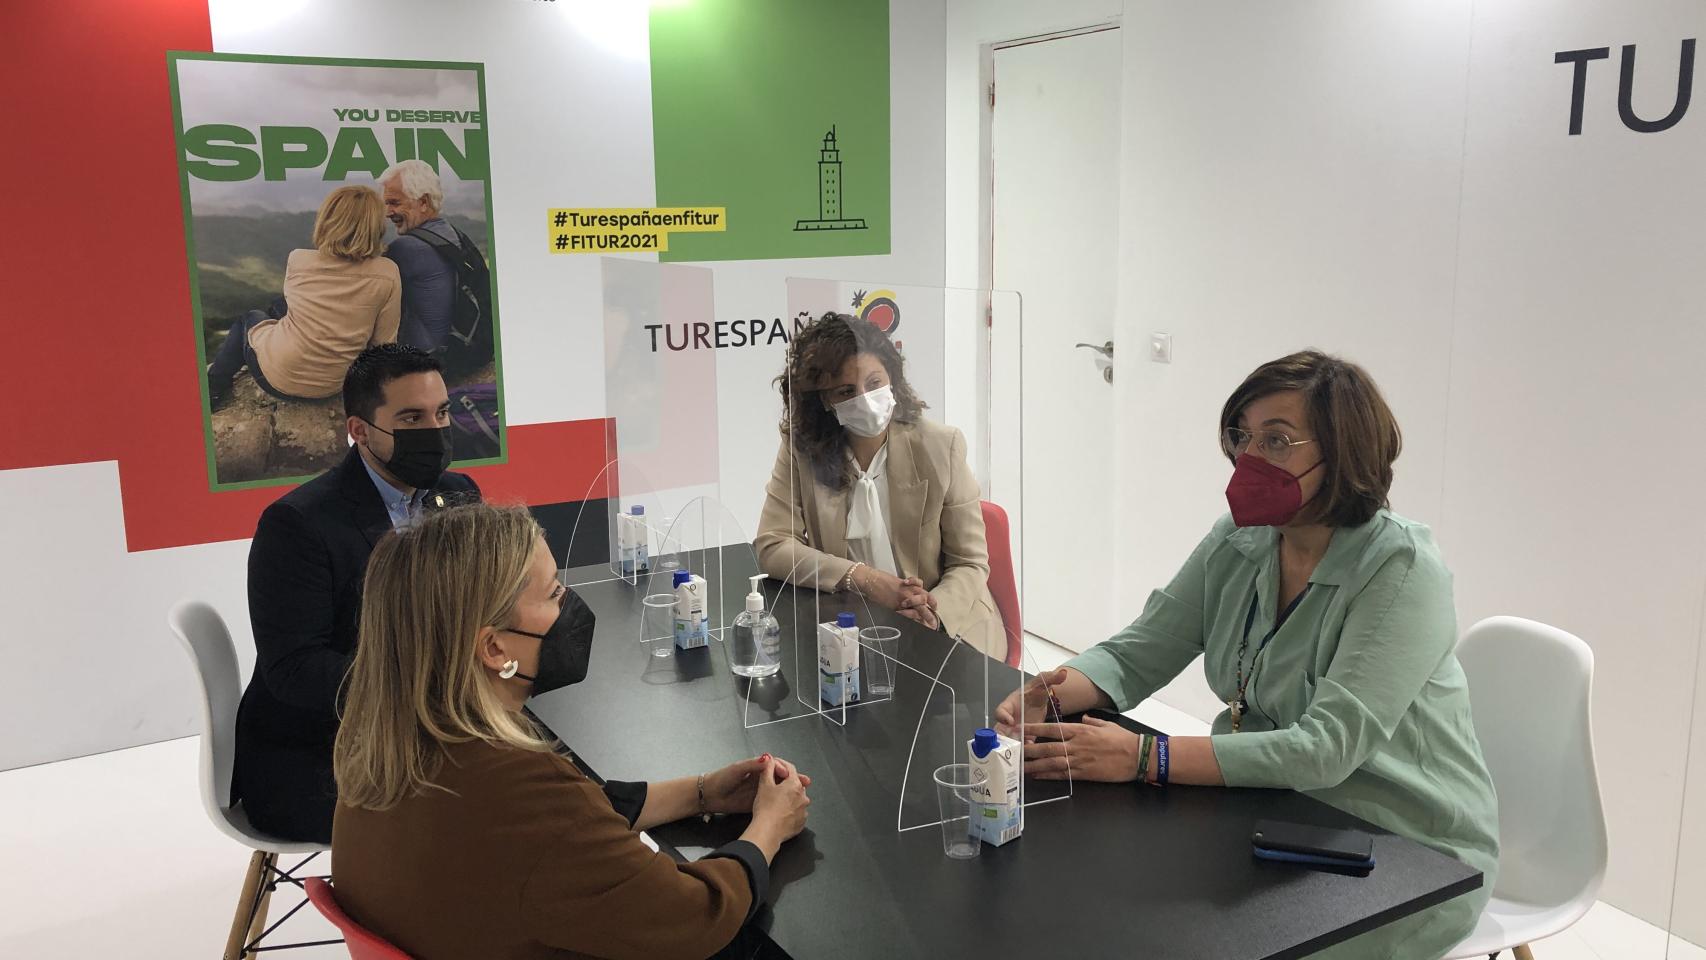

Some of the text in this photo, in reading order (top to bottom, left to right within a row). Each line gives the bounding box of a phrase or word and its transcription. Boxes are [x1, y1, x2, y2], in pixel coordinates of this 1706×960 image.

[1554, 38, 1696, 133] TU
[333, 108, 480, 124] YOU DESERVE
[184, 124, 484, 182] SPAIN
[554, 210, 719, 230] #Turespañaenfitur
[555, 234, 658, 250] #FITUR2021
[644, 311, 813, 352] TURESPAÑ
